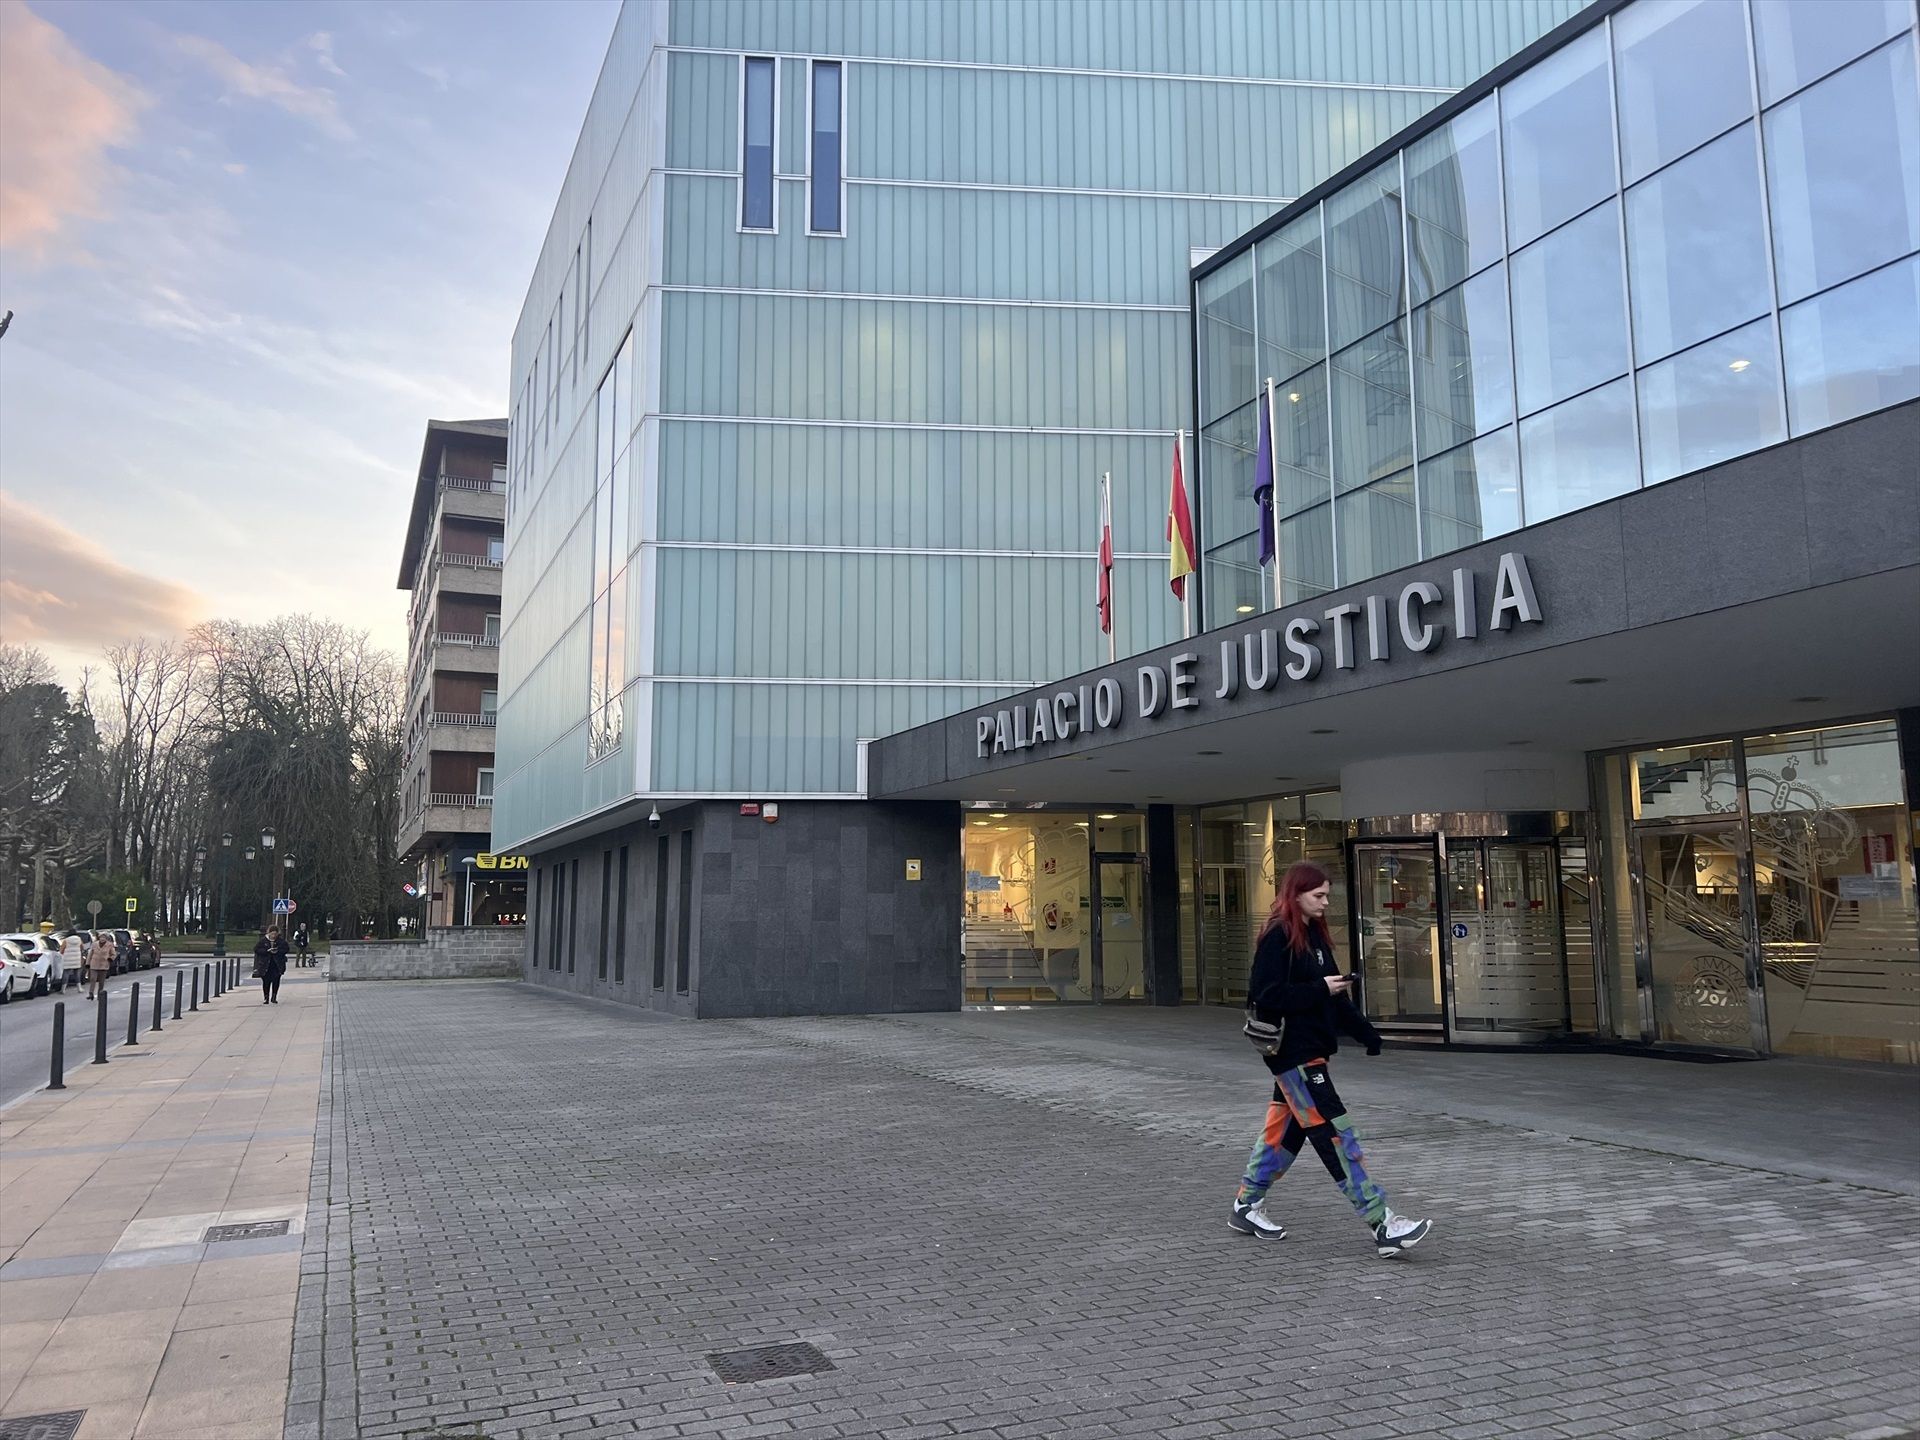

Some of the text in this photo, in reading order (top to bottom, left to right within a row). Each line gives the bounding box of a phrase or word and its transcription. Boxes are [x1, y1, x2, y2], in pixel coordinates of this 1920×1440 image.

[977, 552, 1542, 758] PALACIO DE JUSTICIA
